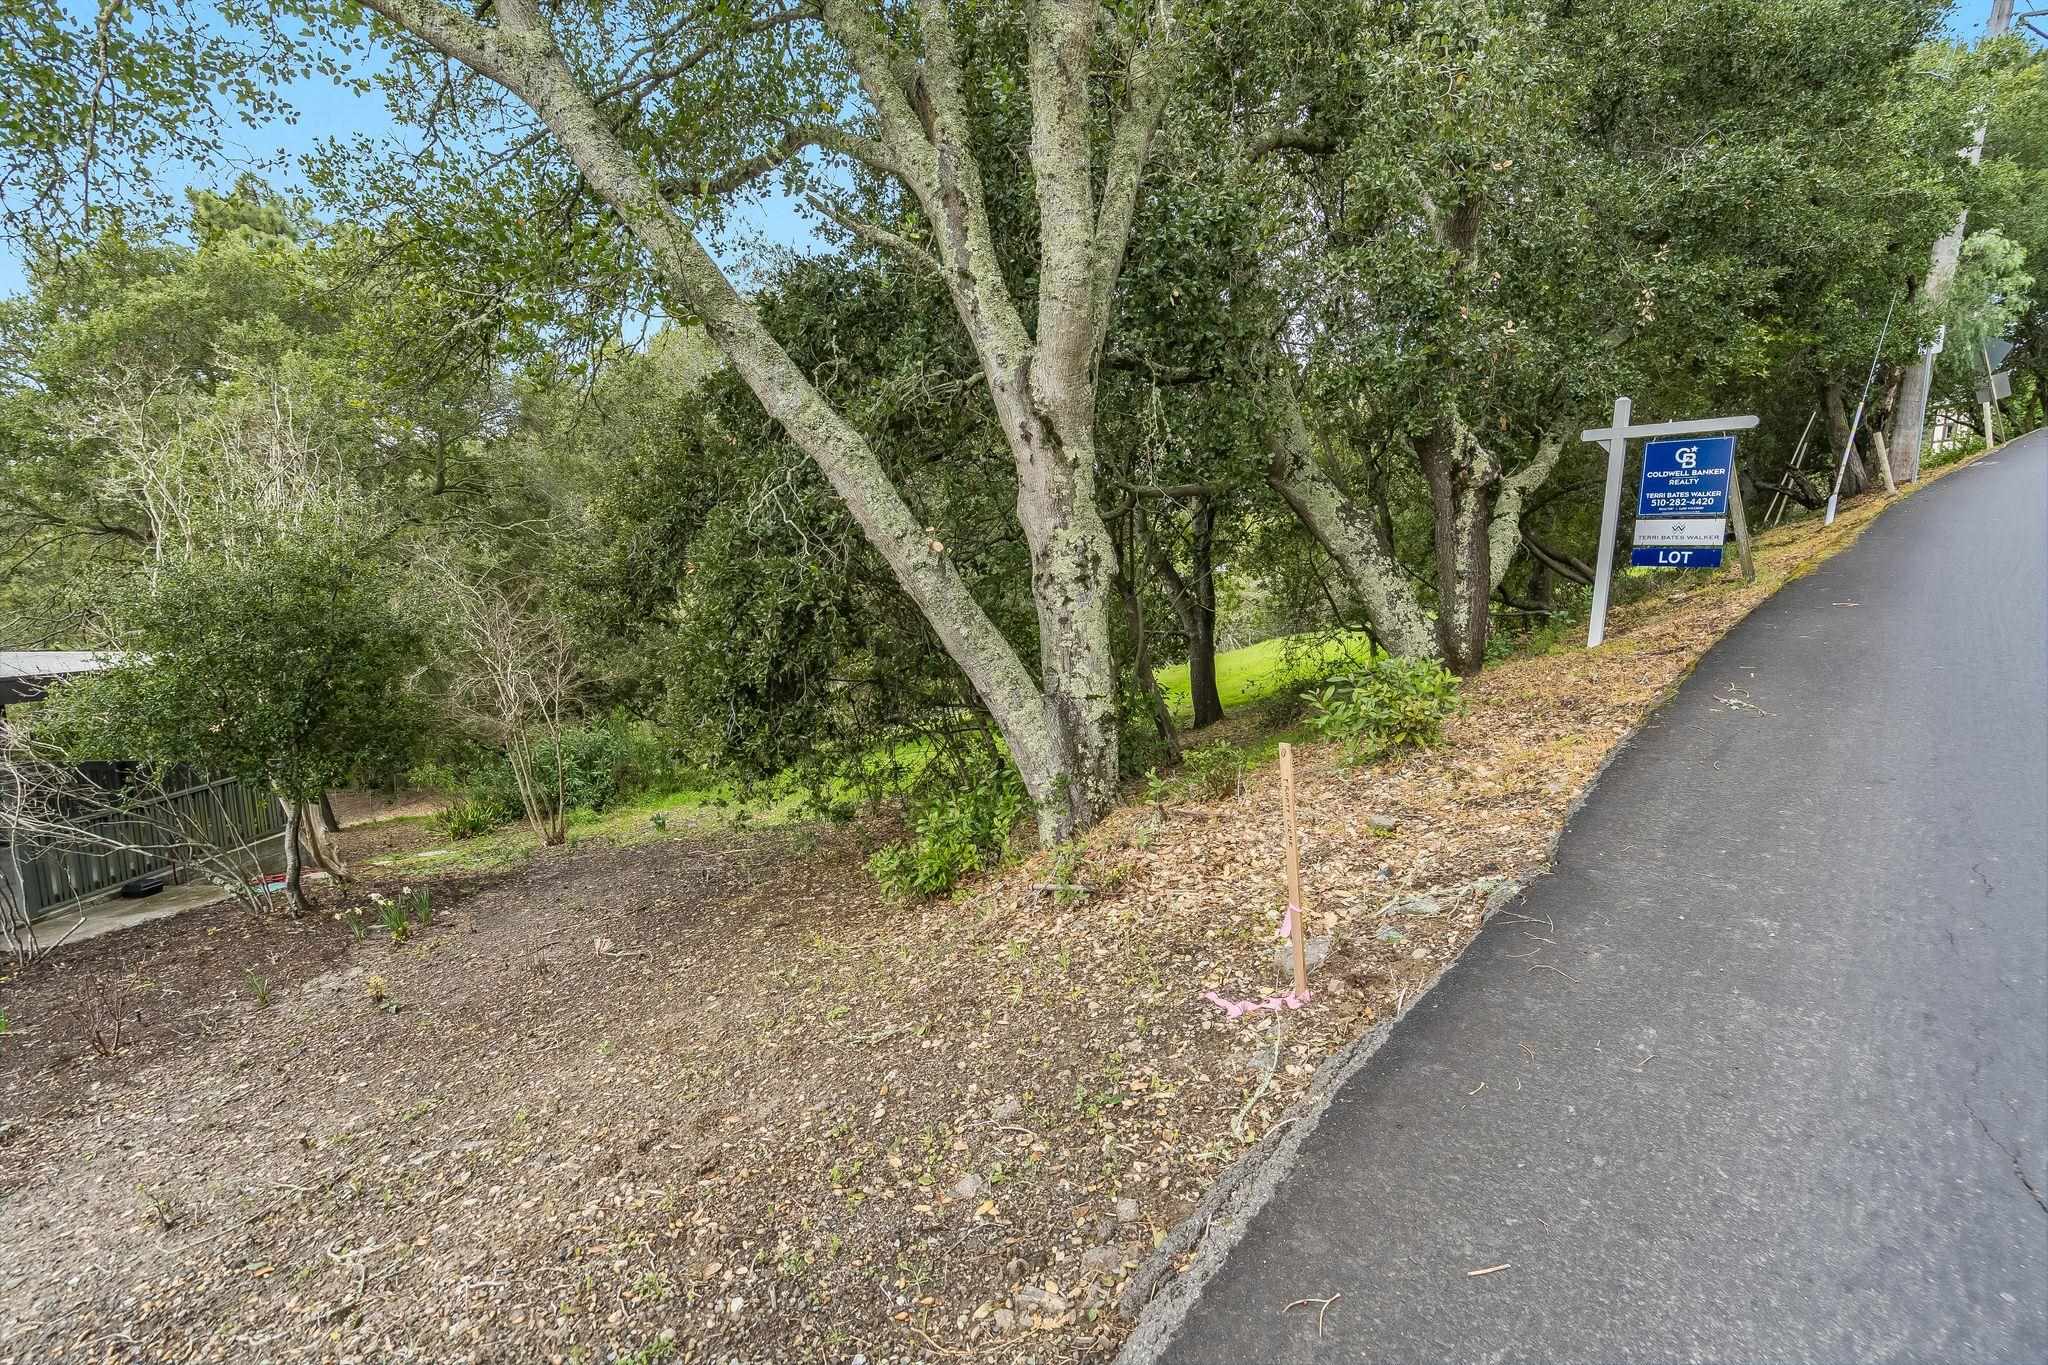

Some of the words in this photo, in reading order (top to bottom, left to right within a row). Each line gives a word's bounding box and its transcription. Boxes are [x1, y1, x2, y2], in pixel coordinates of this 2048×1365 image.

[1647, 470, 1689, 478] COLDWELL
[1691, 468, 1726, 476] BANKER
[1668, 478, 1699, 486] REALTY
[1650, 497, 1714, 507] 510-282-4420
[1658, 551, 1693, 564] LOT
